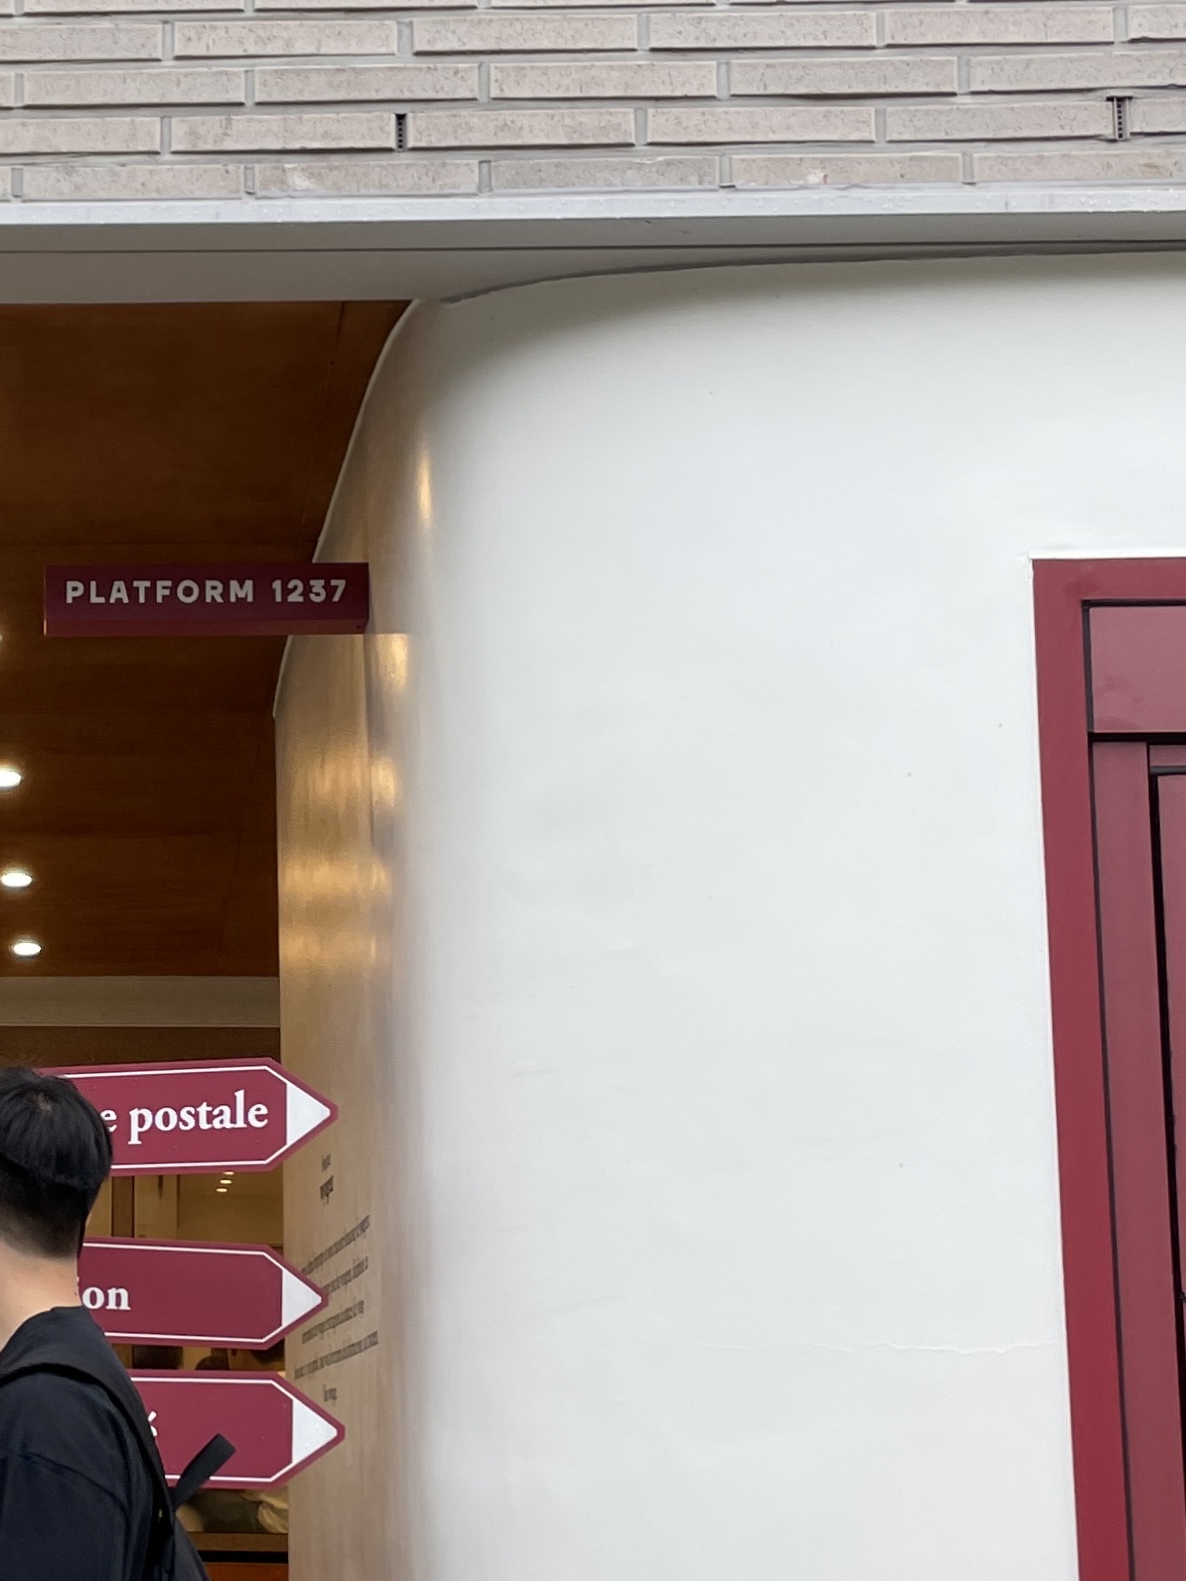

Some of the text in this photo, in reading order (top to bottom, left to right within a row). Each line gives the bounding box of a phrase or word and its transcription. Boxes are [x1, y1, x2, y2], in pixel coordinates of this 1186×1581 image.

[65, 578, 347, 604] PLATFORM 1237
[127, 1089, 269, 1145] postale
